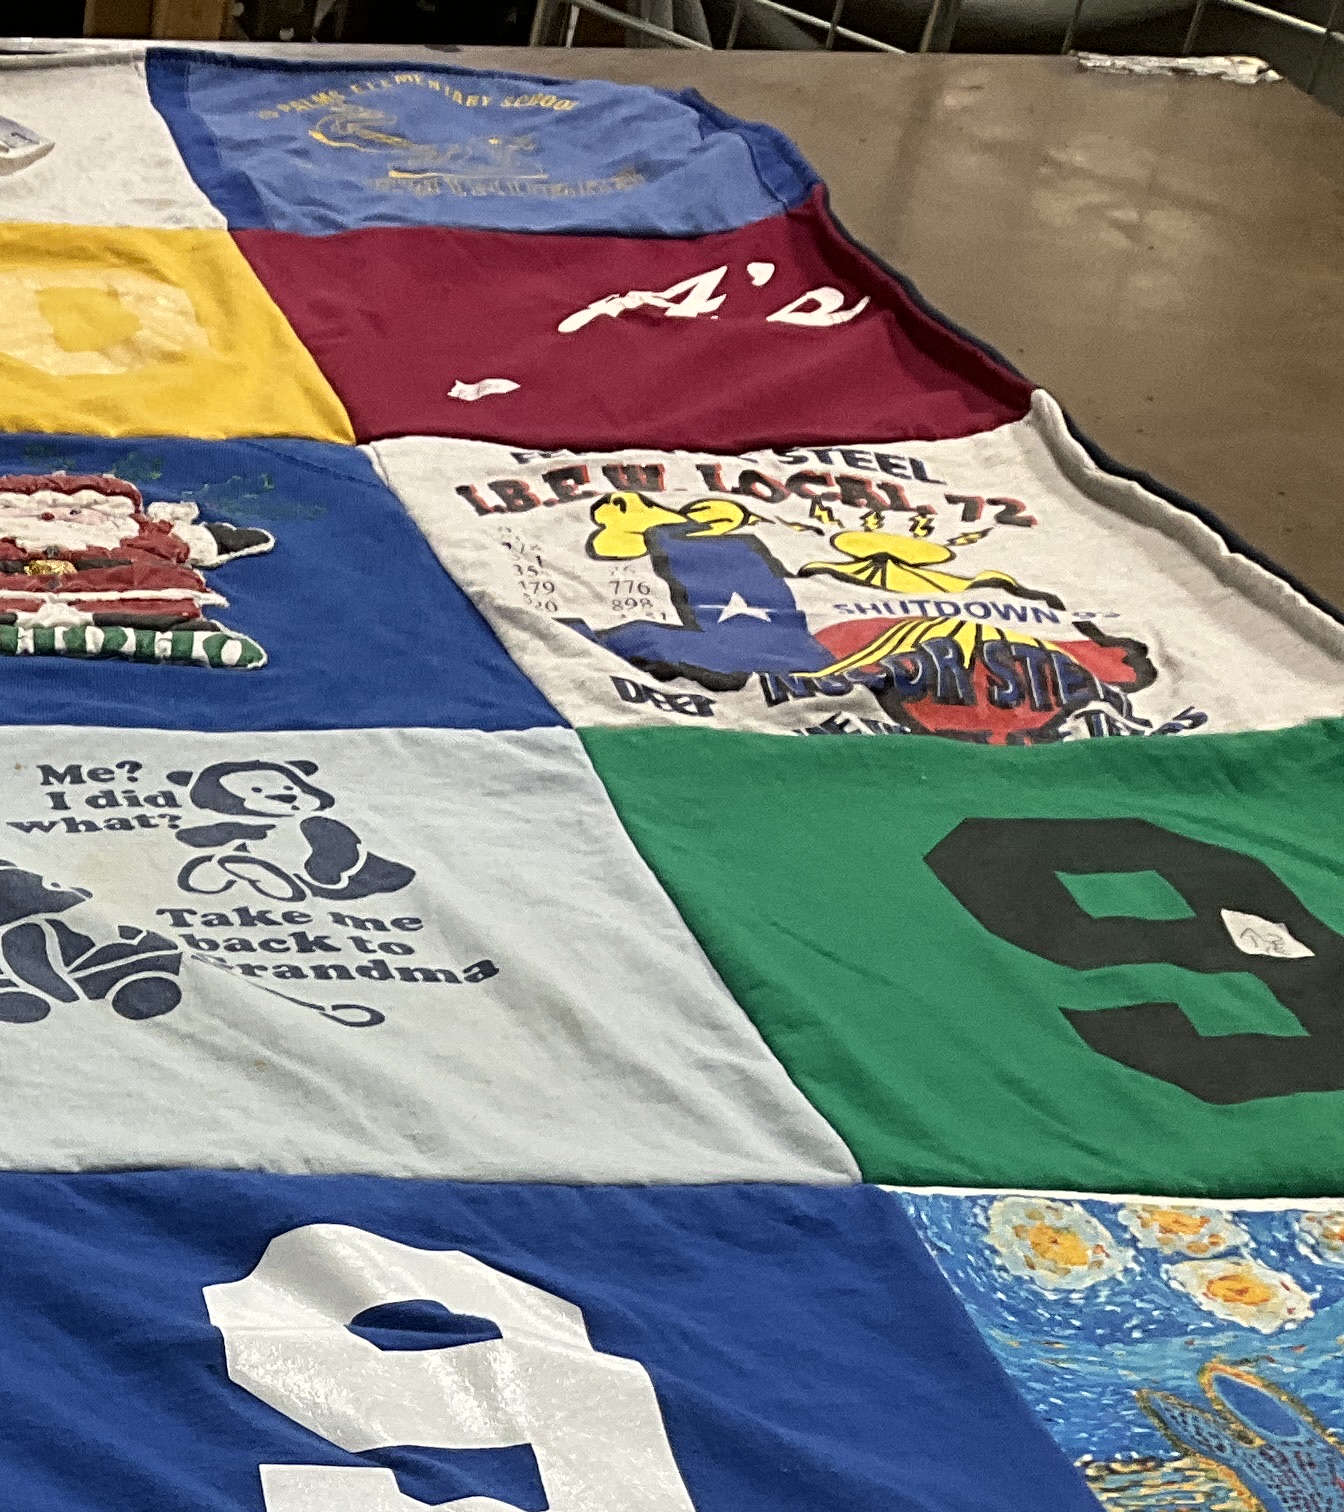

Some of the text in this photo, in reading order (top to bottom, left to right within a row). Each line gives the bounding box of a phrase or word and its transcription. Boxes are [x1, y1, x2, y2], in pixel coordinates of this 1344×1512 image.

[771, 447, 947, 485] STEEL
[944, 493, 1038, 528] 72
[832, 599, 1061, 624] SHUTDOWN
[36, 760, 143, 787] Me?
[48, 788, 183, 811] I did
[7, 811, 183, 835] what?
[156, 906, 424, 933] Take me
[178, 932, 417, 956] back to
[190, 952, 501, 984] randma
[922, 817, 1344, 1106] 9
